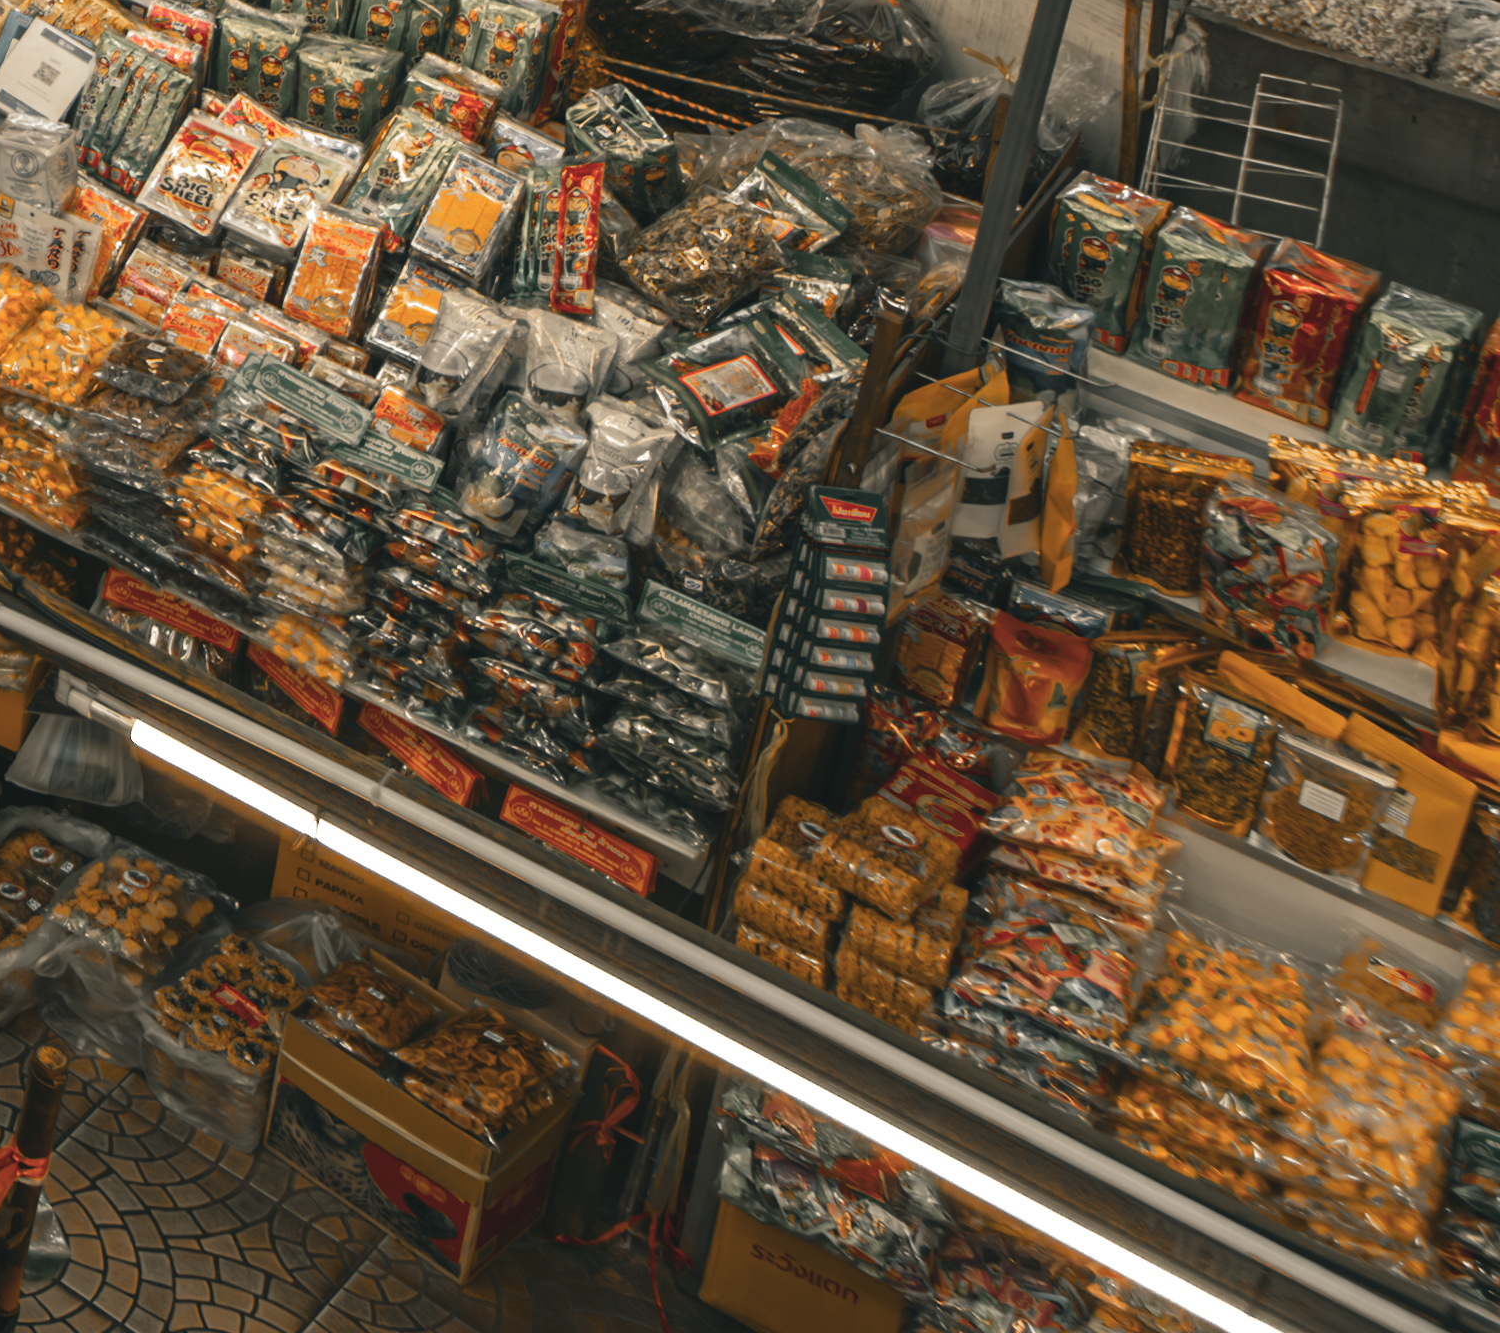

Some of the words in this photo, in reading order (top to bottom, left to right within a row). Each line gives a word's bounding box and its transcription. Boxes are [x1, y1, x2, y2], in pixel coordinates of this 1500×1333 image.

[315, 876, 365, 906] PAPAYA
[750, 1241, 860, 1305] ระวังแตก
